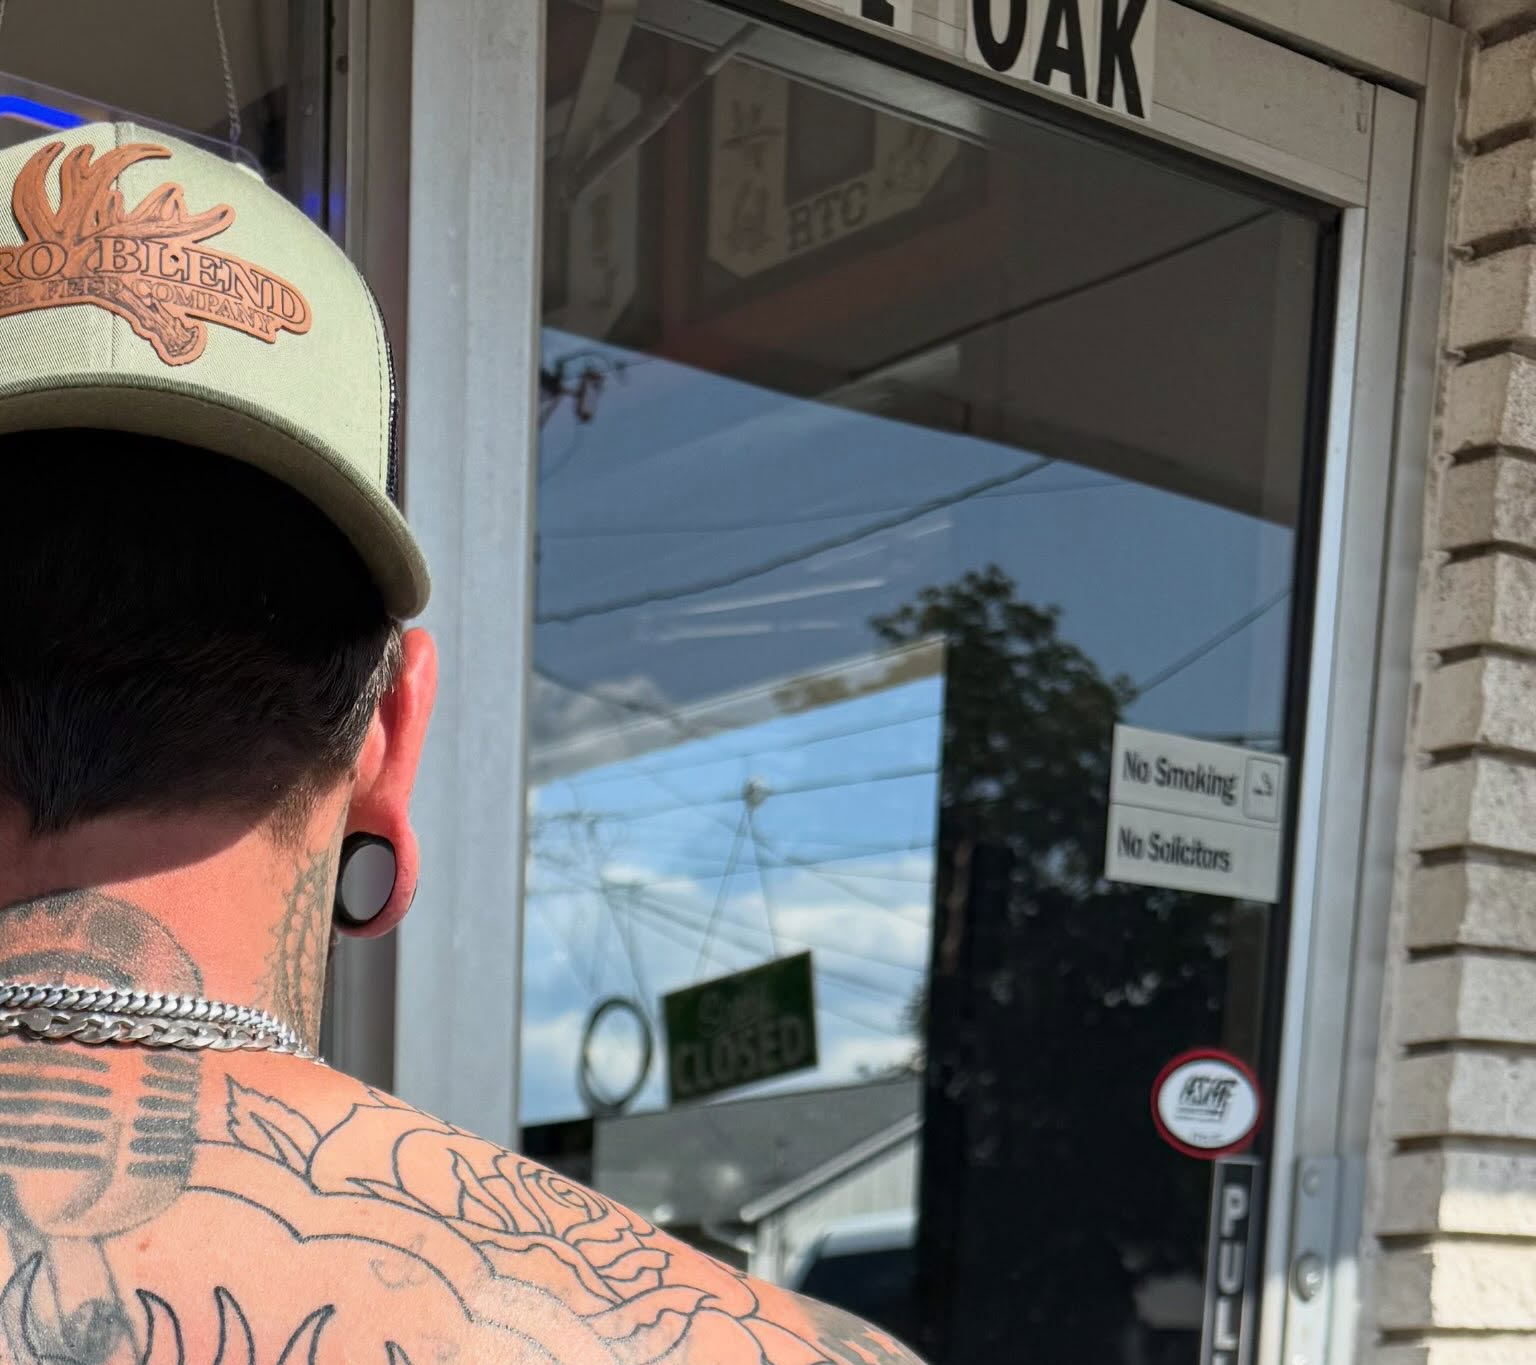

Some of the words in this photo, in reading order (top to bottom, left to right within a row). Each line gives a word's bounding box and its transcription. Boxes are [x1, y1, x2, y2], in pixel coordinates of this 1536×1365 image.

[972, 0, 1145, 119] OAK
[95, 236, 306, 324] BLEND
[132, 278, 275, 334] COMPANY
[1123, 750, 1149, 784] No
[1153, 755, 1238, 807] Smoking
[1117, 826, 1143, 860] No
[1147, 831, 1232, 873] Solicitors
[672, 1015, 806, 1093] CLOSED
